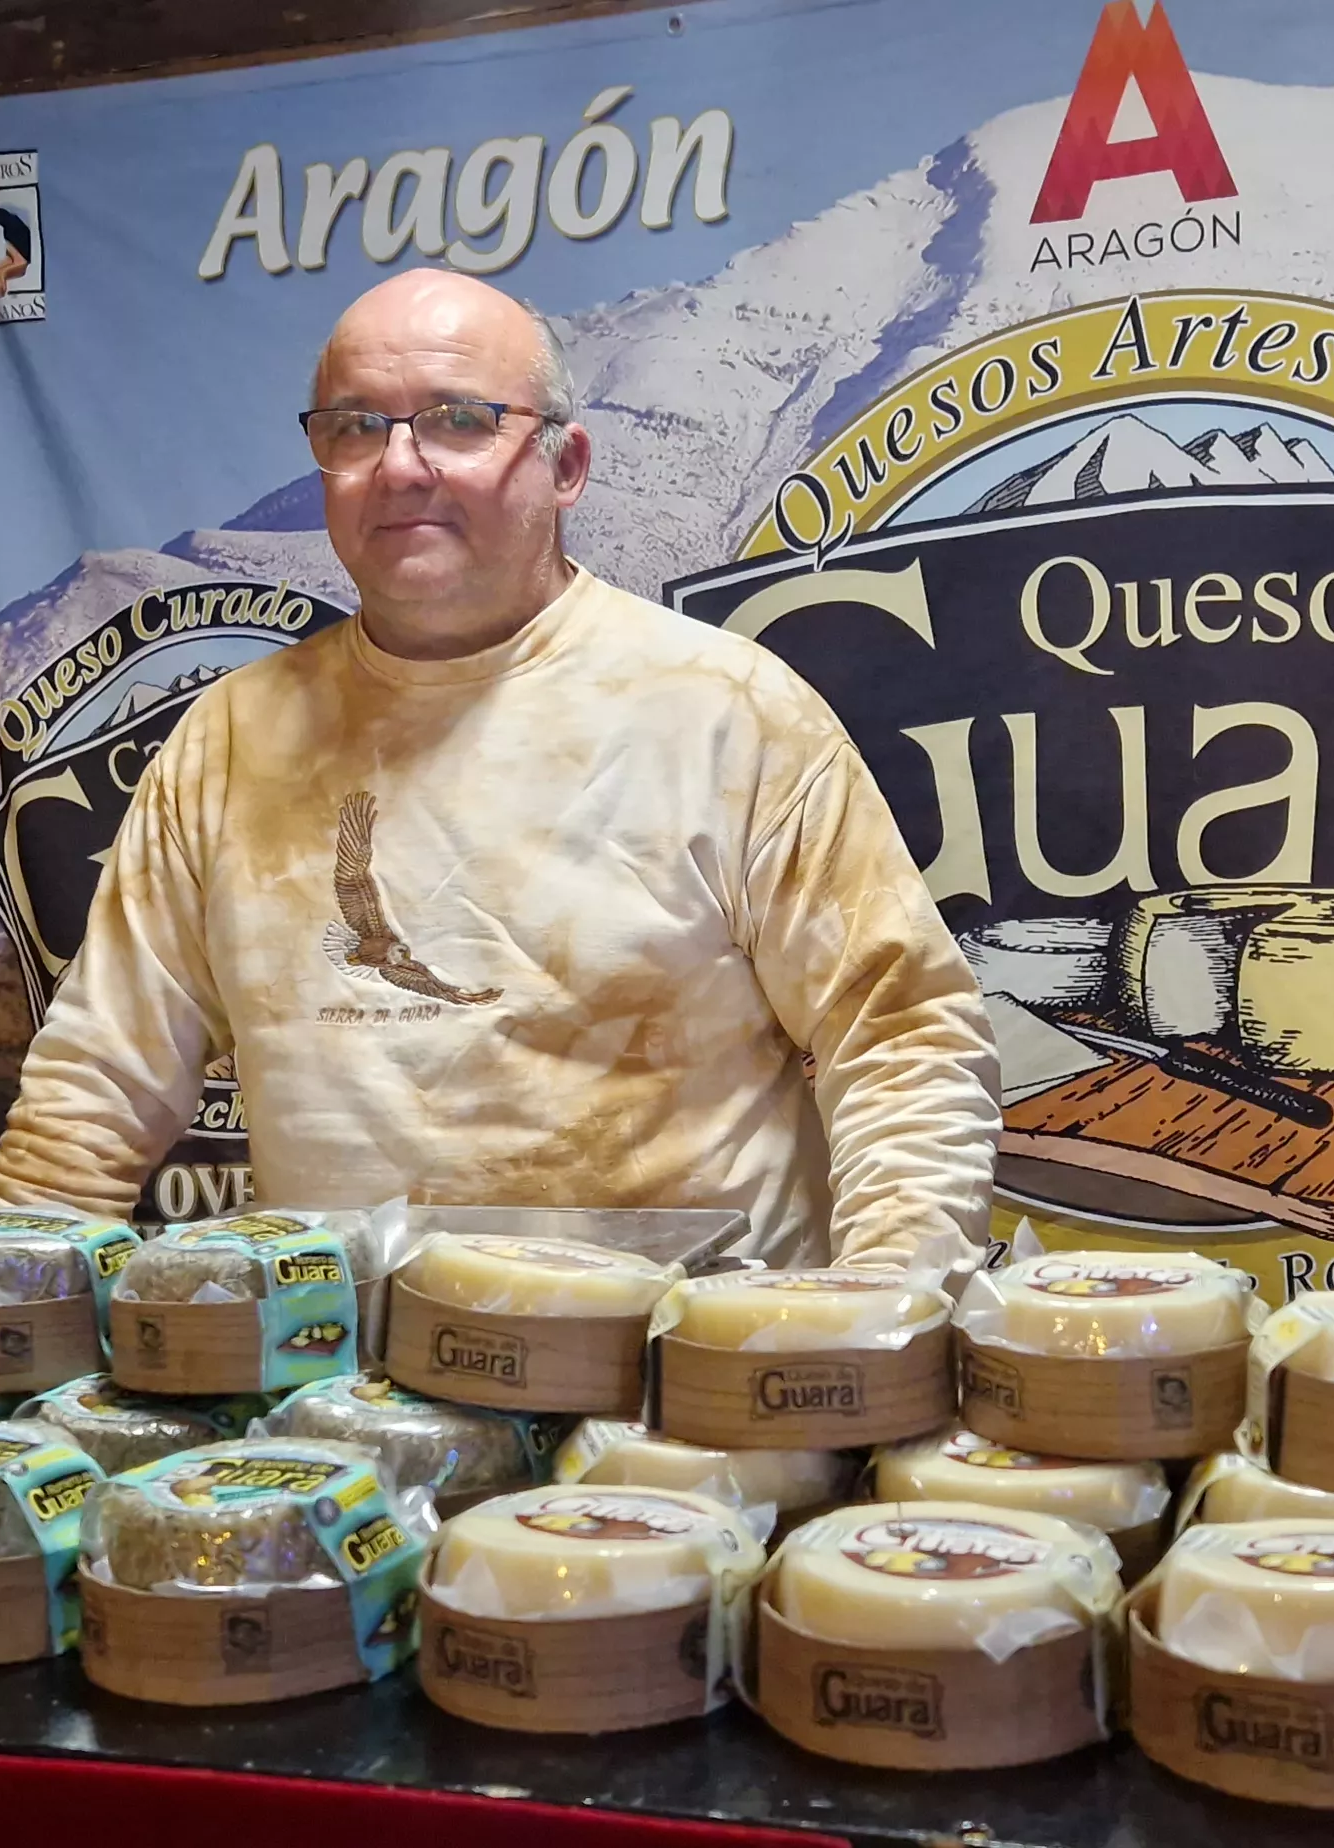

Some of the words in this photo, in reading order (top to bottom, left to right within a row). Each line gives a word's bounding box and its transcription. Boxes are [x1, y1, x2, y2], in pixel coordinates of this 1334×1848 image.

[197, 85, 734, 280] Aragón
[1030, 207, 1241, 273] ARAGÓN
[774, 333, 1064, 569] Quesos
[130, 580, 313, 641] Curado
[274, 1254, 342, 1284] Guara
[437, 1327, 516, 1376] Guara
[760, 1370, 854, 1410] Guara
[820, 1668, 930, 1724] Guara
[1200, 1691, 1323, 1757] Guara
